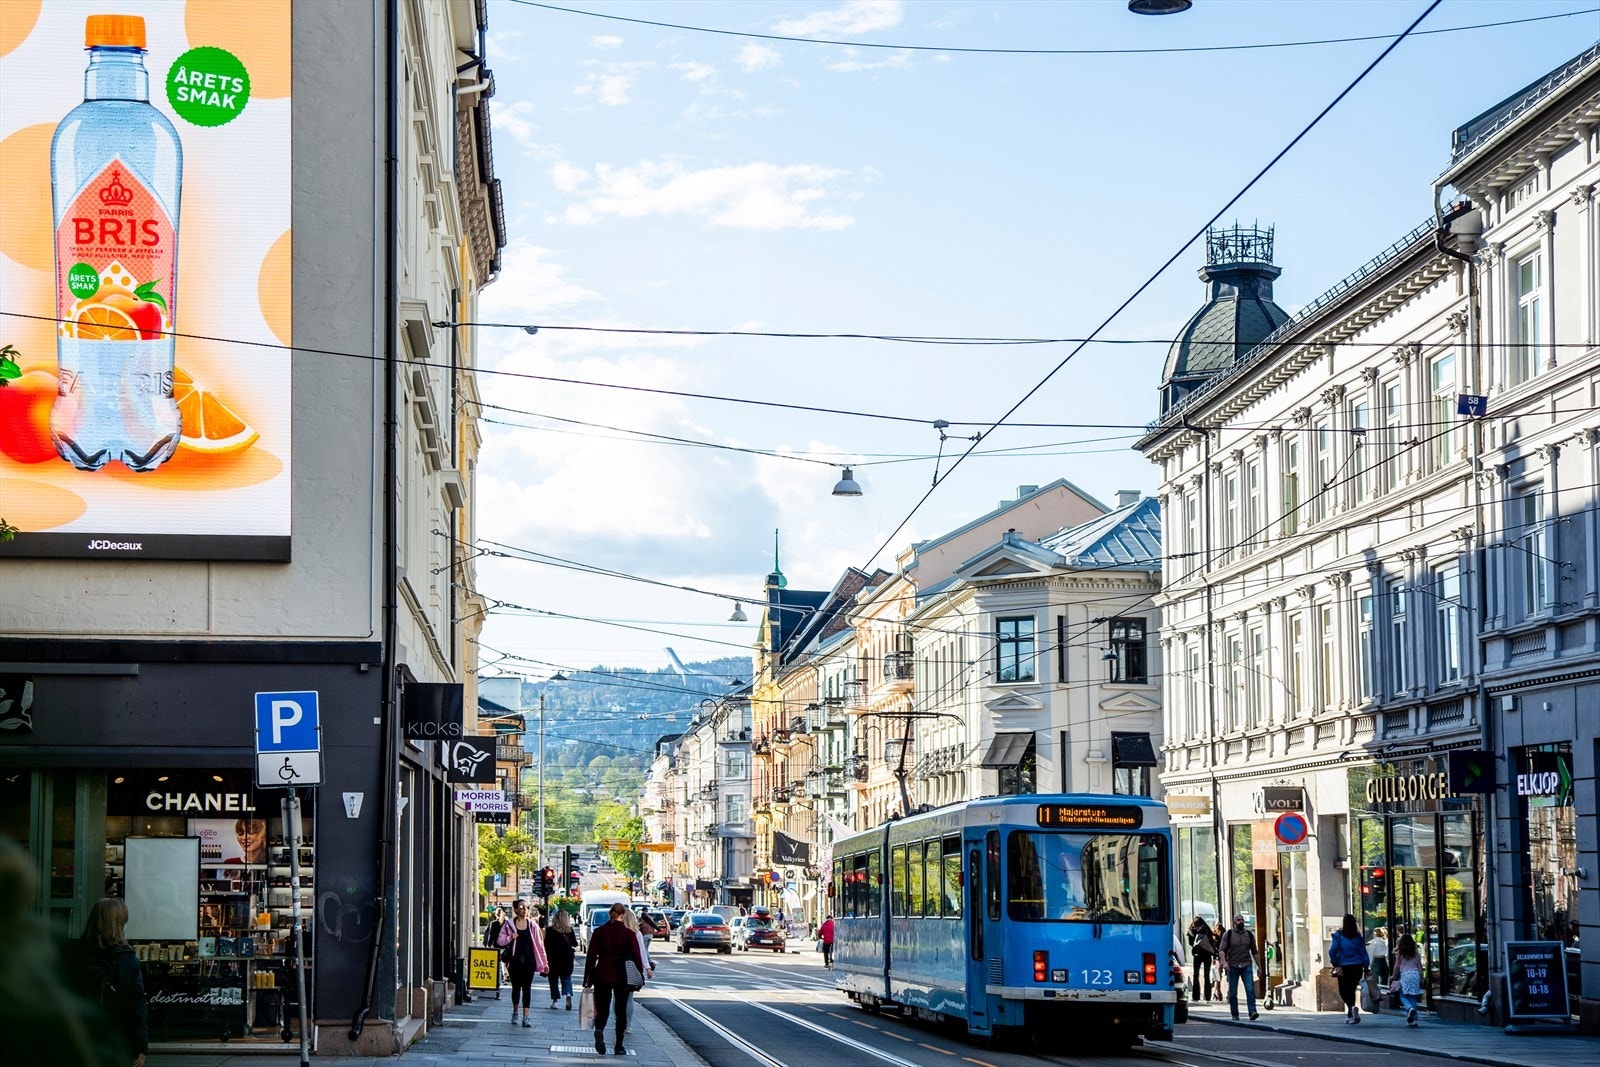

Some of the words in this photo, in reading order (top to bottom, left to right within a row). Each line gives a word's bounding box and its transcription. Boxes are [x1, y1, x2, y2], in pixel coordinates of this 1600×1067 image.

[174, 66, 244, 93] ÅRETS
[176, 86, 236, 110] SMAK
[72, 218, 160, 246] BRIS
[70, 273, 97, 283] ÅRETS
[71, 282, 94, 290] SMAK
[1467, 396, 1479, 405] 58
[88, 540, 142, 550] JCDecaux
[271, 700, 303, 744] P
[408, 722, 460, 736] KICKS
[461, 792, 500, 800] MORRIS
[145, 792, 257, 811] CHANEL
[1187, 800, 1207, 809] BOK
[1268, 799, 1301, 809] VOLT
[473, 958, 495, 968] SALE
[475, 971, 492, 980] 70%
[1081, 969, 1113, 985] 123
[1527, 968, 1547, 978] 10-19
[1528, 985, 1549, 994] 10-18
